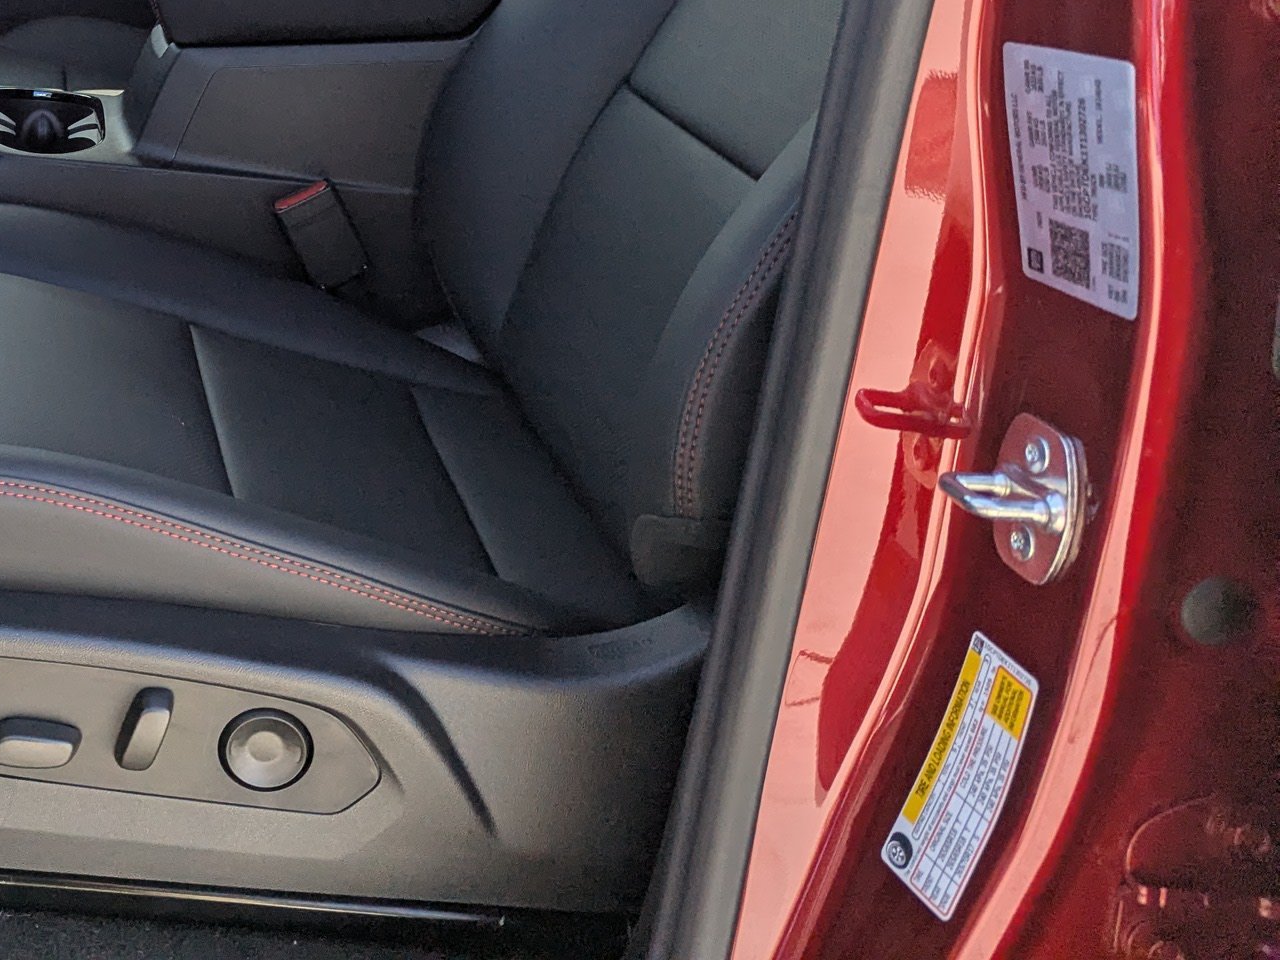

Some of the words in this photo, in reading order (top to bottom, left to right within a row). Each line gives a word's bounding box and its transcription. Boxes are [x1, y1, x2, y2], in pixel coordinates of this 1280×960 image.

[915, 778, 929, 798] TIRE
[924, 762, 936, 782] AND
[932, 729, 951, 766] LOADING
[945, 679, 969, 732] INFORMATION
